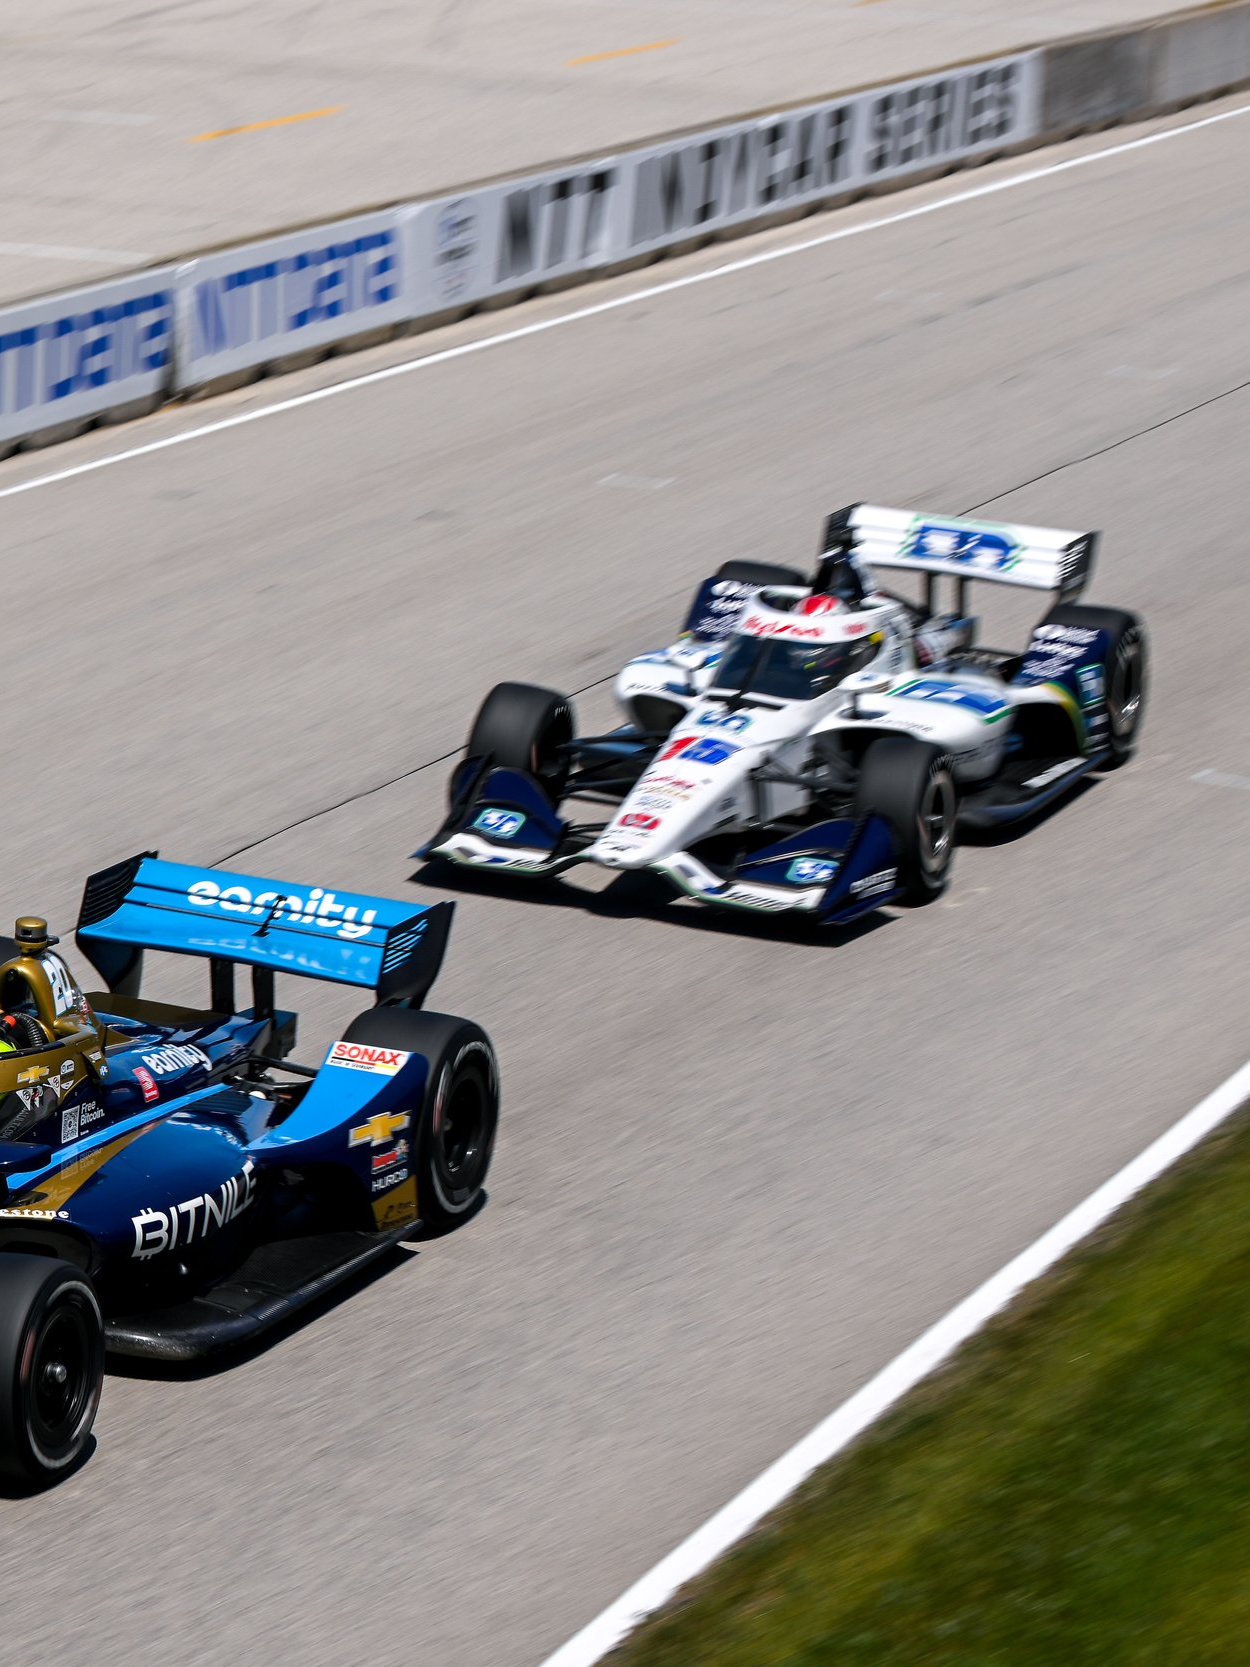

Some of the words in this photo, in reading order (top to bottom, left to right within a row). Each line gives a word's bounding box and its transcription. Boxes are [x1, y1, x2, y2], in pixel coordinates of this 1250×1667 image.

[187, 880, 377, 939] earnity
[335, 1044, 402, 1065] SONAX
[80, 1101, 96, 1114] Free
[131, 1160, 257, 1261] BITNILE
